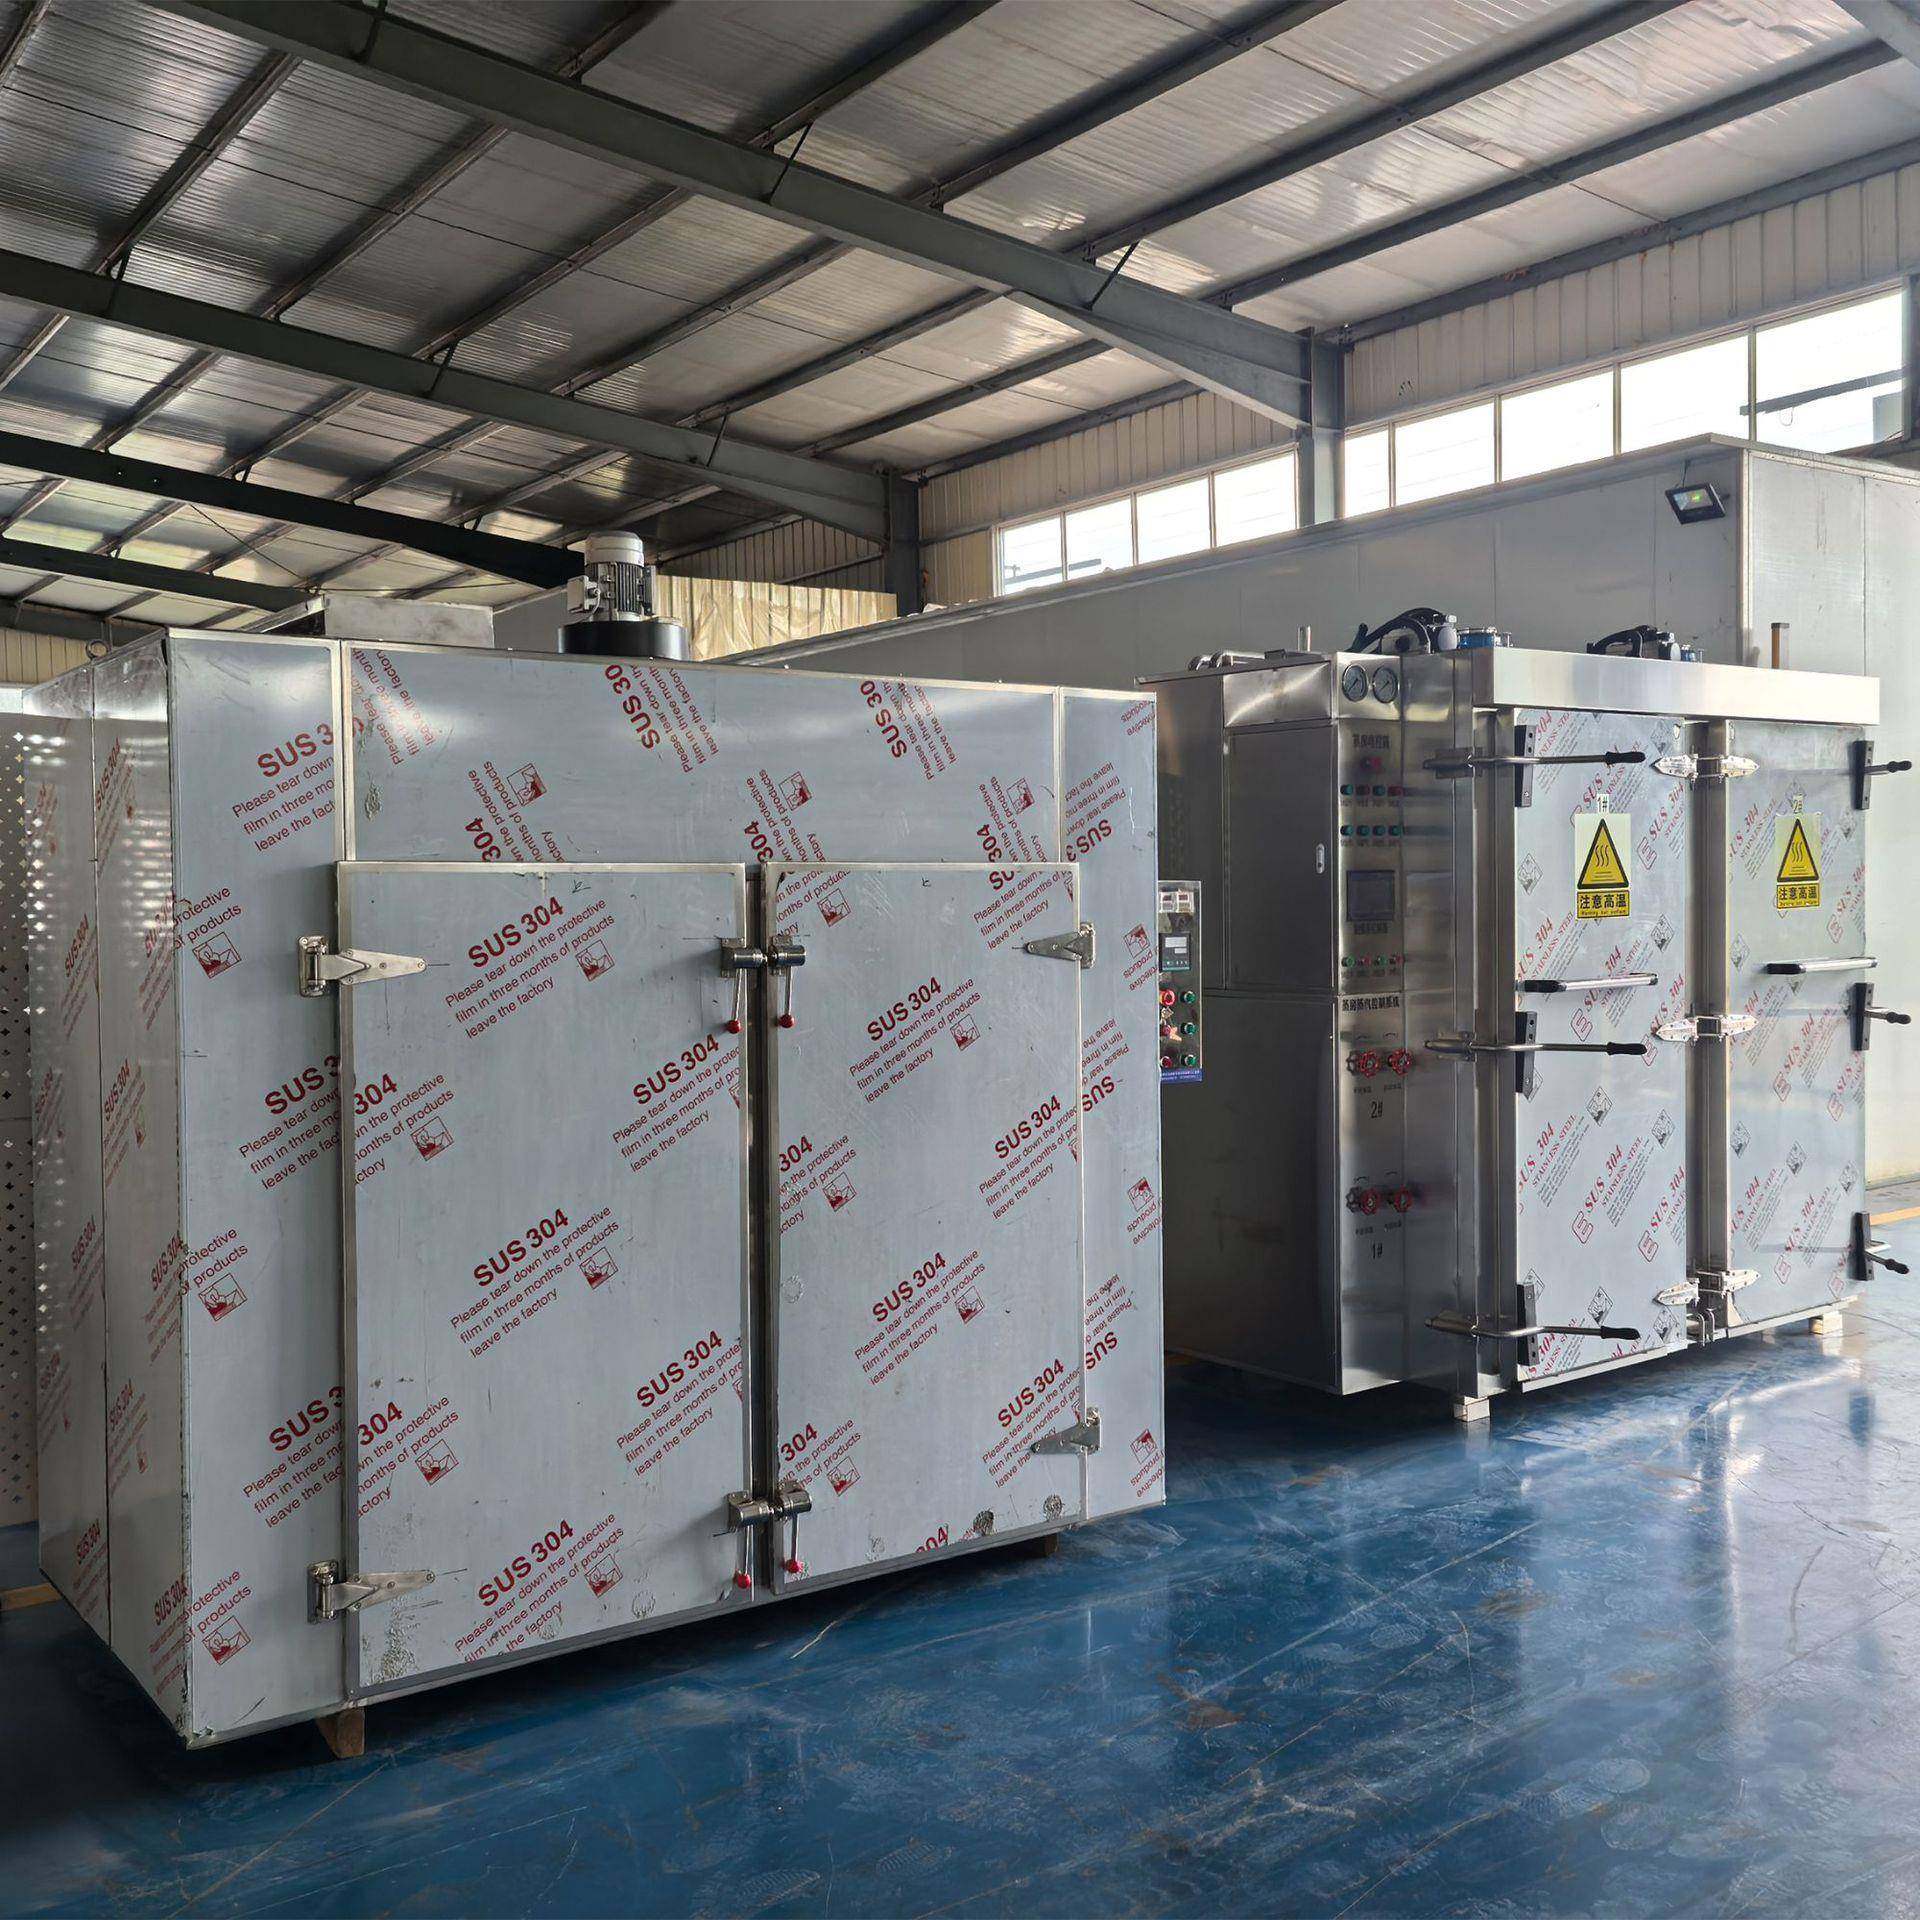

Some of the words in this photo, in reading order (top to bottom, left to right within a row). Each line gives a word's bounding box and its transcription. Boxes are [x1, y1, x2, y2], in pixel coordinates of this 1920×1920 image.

[621, 695, 661, 748] SUS
[655, 711, 673, 734] tear
[684, 730, 695, 743] in
[687, 704, 703, 723] the
[873, 708, 908, 758] SUS
[256, 732, 317, 777] SUS
[668, 734, 694, 773] Please
[690, 741, 707, 764] film
[698, 724, 719, 756] leave
[231, 788, 276, 818] Please
[275, 773, 301, 793] tear
[242, 816, 269, 835] film
[266, 809, 282, 822] in
[280, 790, 315, 814] three
[253, 827, 290, 852] leave
[289, 814, 312, 833] the
[1580, 893, 1627, 909] 注意高温
[1779, 886, 1817, 901] 注意高温
[186, 904, 241, 944] products
[467, 923, 522, 968] SUS
[520, 895, 564, 935] 304
[1534, 916, 1554, 950] 304
[444, 978, 485, 1008] Please
[483, 963, 507, 982] tear
[508, 943, 538, 967] down
[536, 932, 556, 948] the
[555, 899, 606, 938] protective
[454, 1004, 478, 1023] film
[476, 997, 490, 1009] in
[488, 977, 519, 1001] three
[519, 951, 559, 982] months
[558, 941, 570, 957] of
[570, 914, 615, 951] products
[464, 1014, 497, 1039] leave
[496, 1001, 517, 1019] the
[515, 975, 554, 1005] factory
[866, 1001, 909, 1041] SUS
[907, 975, 941, 1011] 304
[1668, 972, 1686, 1004] 304
[848, 1050, 880, 1077] Please
[878, 1036, 897, 1054] tear
[898, 1018, 921, 1040] down
[920, 1008, 935, 1023] the
[934, 978, 974, 1013] protective
[856, 1073, 875, 1090] film
[873, 1066, 884, 1078] in
[882, 1048, 907, 1070] three
[906, 1025, 937, 1053] months
[936, 1015, 946, 1029] of
[945, 991, 981, 1024] products
[263, 1066, 325, 1115] SUS
[632, 1060, 681, 1105] SUS
[679, 1032, 719, 1071] 304
[863, 1081, 889, 1104] leave
[888, 1069, 905, 1086] the
[903, 1046, 934, 1073] factory
[349, 1072, 397, 1115] 304
[389, 1073, 445, 1117] protective
[405, 1089, 454, 1130] products
[1078, 1074, 1115, 1113] SUS
[1371, 1101, 1383, 1119] 2#
[993, 1119, 1032, 1159] SUS
[1029, 1094, 1061, 1129] 304
[1536, 1122, 1556, 1157] 304
[775, 1134, 813, 1172] 304
[1584, 1176, 1606, 1214] SUS
[1604, 1144, 1623, 1178] 304
[1650, 1196, 1669, 1233] SUS
[1667, 1165, 1686, 1198] 304
[192, 1244, 248, 1289] products
[449, 1296, 489, 1329] Please
[488, 1279, 511, 1300] tear
[513, 1257, 543, 1283] down
[541, 1244, 561, 1261] the
[560, 1206, 611, 1249] protective
[472, 1239, 527, 1287] SUS
[525, 1207, 569, 1249] 304
[1372, 1243, 1383, 1259] 1#
[459, 1324, 483, 1344] film
[480, 1315, 494, 1328] in
[492, 1292, 524, 1318] three
[523, 1263, 563, 1296] months
[562, 1251, 575, 1267] of
[574, 1221, 619, 1261] products
[853, 1331, 885, 1360] Please
[883, 1315, 902, 1334] tear
[902, 1295, 926, 1319] down
[924, 1283, 940, 1299] the
[939, 1250, 979, 1288] protective
[871, 1279, 914, 1322] SUS
[911, 1251, 946, 1288] 304
[468, 1331, 501, 1358] leave
[500, 1316, 521, 1335] the
[519, 1287, 557, 1319] factory
[861, 1355, 880, 1373] film
[878, 1347, 889, 1359] in
[887, 1327, 912, 1350] three
[911, 1300, 942, 1331] months
[941, 1290, 951, 1304] of
[950, 1262, 985, 1298] products
[635, 1361, 685, 1408] SUS
[682, 1329, 722, 1370] 304
[868, 1361, 894, 1386] leave
[893, 1348, 909, 1365] the
[908, 1322, 938, 1351] factory
[1081, 1330, 1118, 1370] SUS
[996, 1386, 1035, 1428] SUS
[1032, 1357, 1064, 1394] 304
[268, 1399, 329, 1451] SUS
[354, 1400, 402, 1446] 304
[780, 1422, 817, 1462] 304
[477, 1555, 531, 1606] SUS
[530, 1519, 574, 1563] 304
[196, 1585, 251, 1634] products
